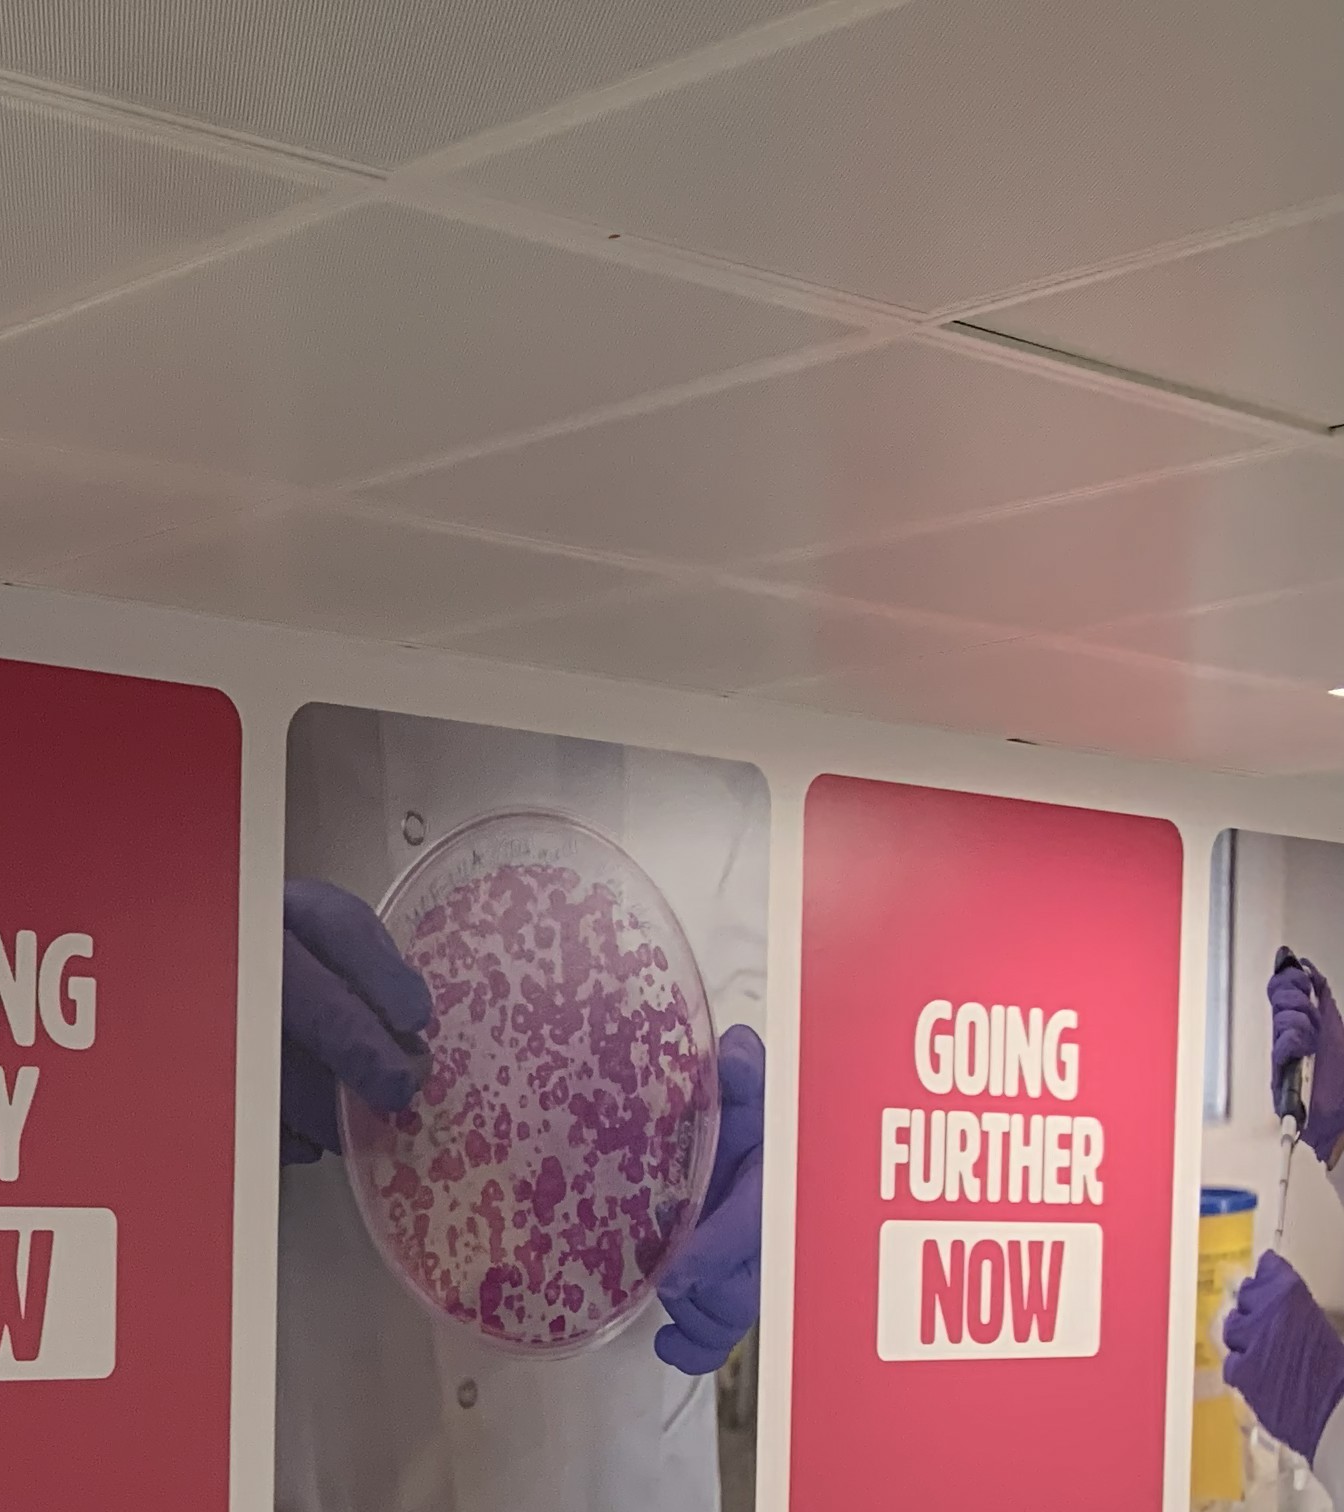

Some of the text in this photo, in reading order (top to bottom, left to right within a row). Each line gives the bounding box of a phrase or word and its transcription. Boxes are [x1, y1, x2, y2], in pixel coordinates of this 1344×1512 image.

[914, 1000, 1079, 1101] GOING
[880, 1107, 1104, 1205] FURTHER
[920, 1239, 1065, 1345] NOW
